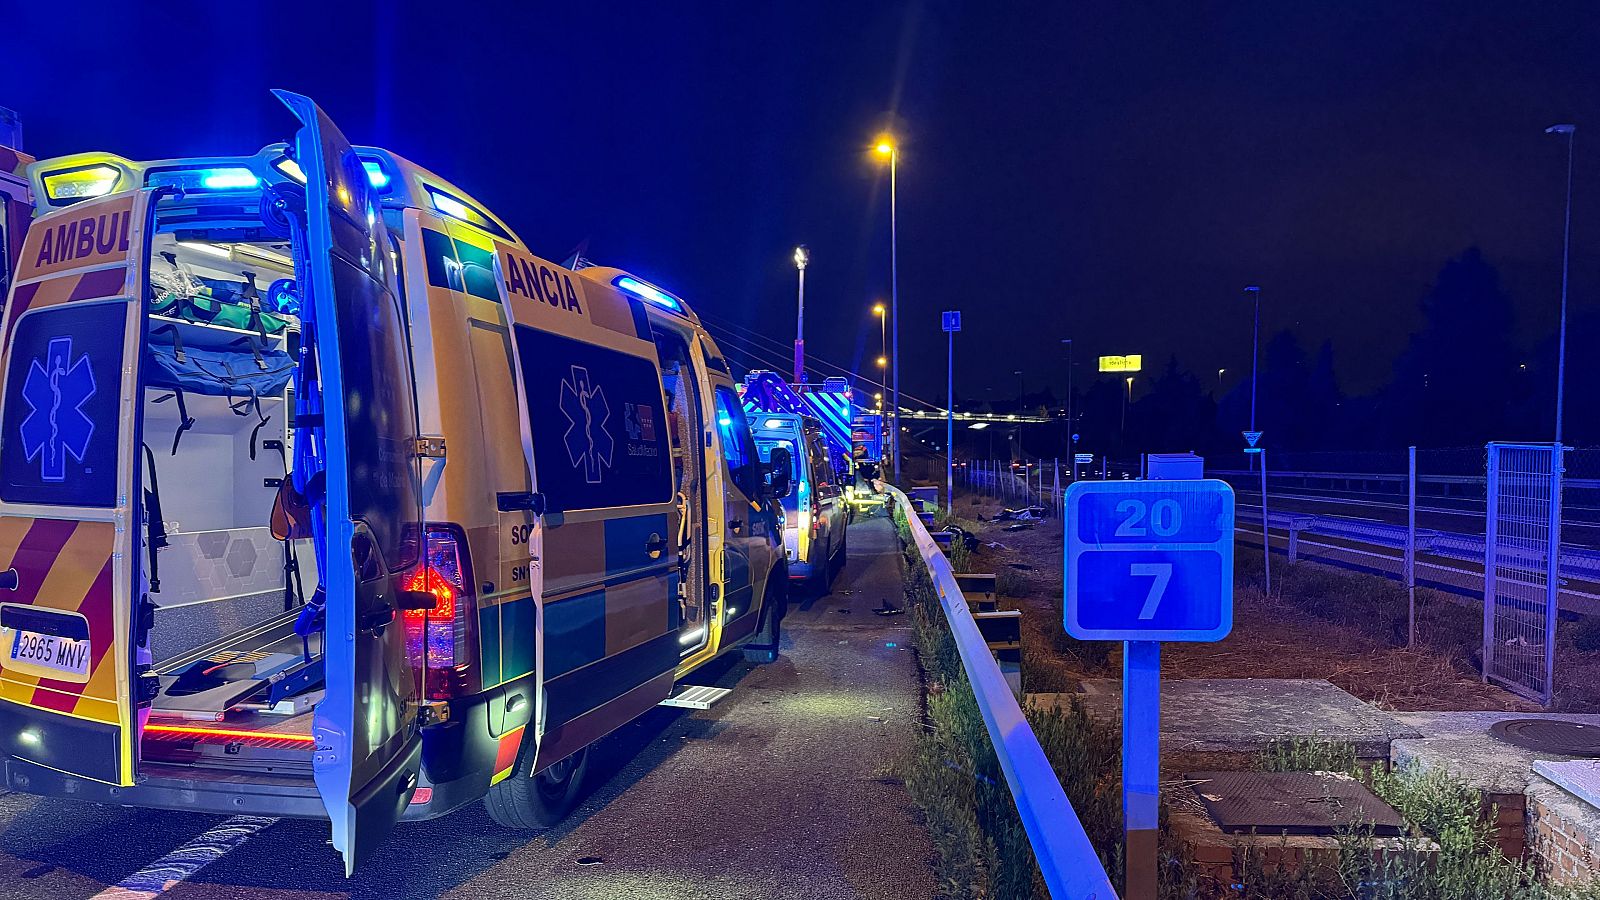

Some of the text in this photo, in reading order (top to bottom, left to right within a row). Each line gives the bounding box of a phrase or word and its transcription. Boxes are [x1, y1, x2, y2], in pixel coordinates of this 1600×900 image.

[35, 210, 131, 267] AMBUL
[505, 252, 582, 314] ANCIA
[1114, 499, 1182, 537] 20
[1130, 563, 1173, 620] 7
[20, 634, 87, 669] 2965 MNV
